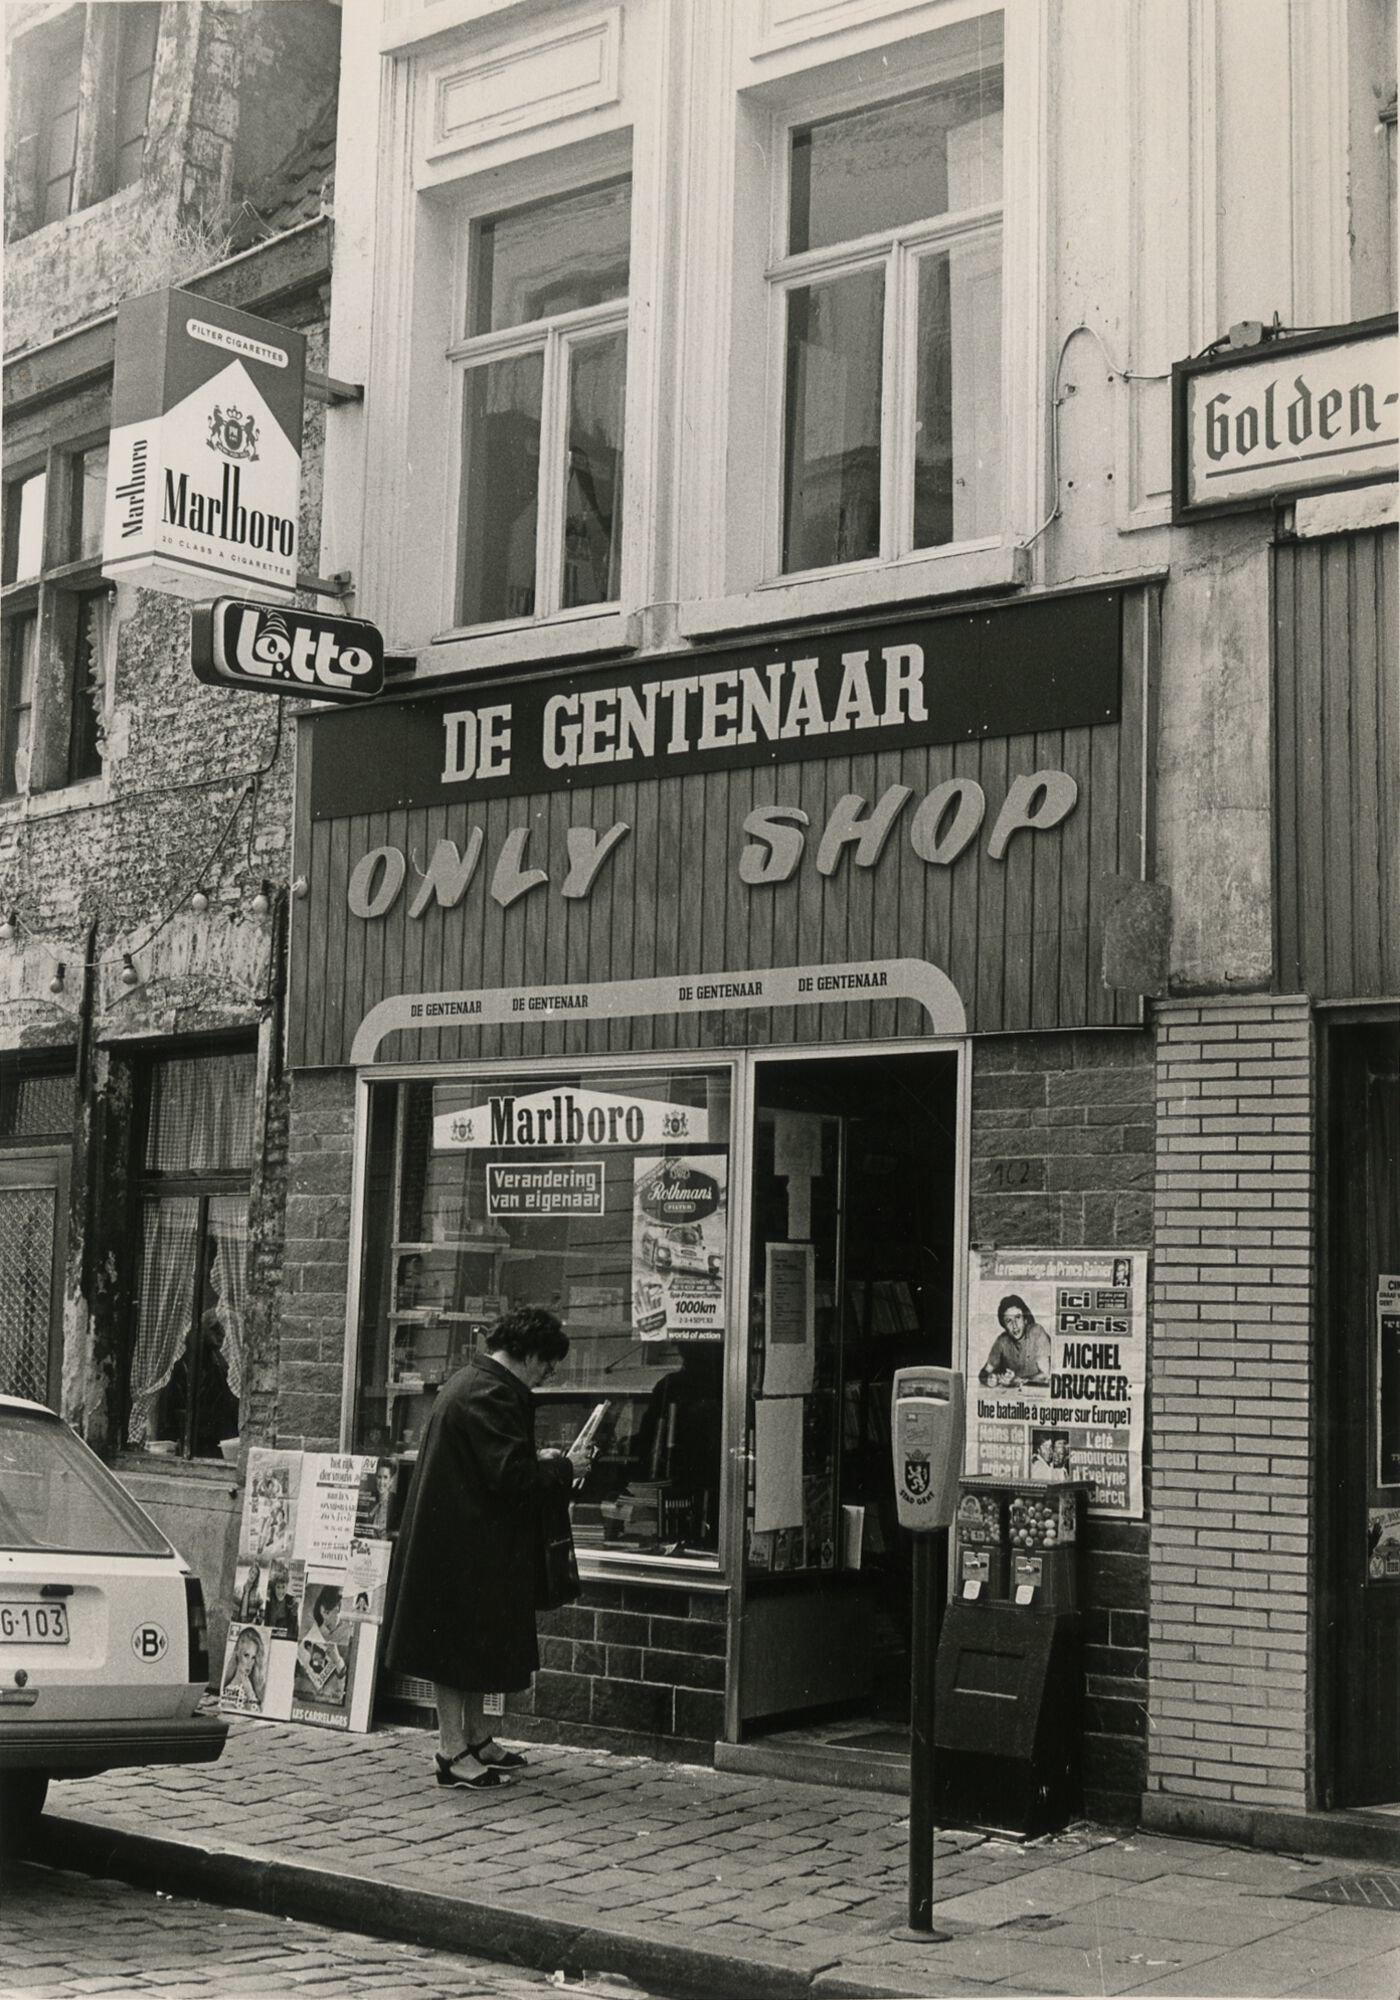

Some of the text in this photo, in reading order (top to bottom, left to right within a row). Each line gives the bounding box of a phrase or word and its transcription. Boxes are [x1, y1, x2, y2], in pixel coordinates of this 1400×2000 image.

[192, 324, 283, 362] FILTER CIGARETTES
[115, 440, 148, 538] Marlboro
[161, 462, 294, 557] Marlboro
[179, 540, 212, 555] CLASS
[231, 554, 291, 576] CIGARETTES
[236, 608, 373, 689] Lotto
[441, 643, 929, 783] DE GENTENAAR
[347, 769, 1079, 920] ONLY SHOP
[678, 981, 763, 1001] DE GENTENAAR
[798, 972, 888, 992] DE GENTENAAR
[410, 1000, 482, 1018] DE GENTENAAR
[512, 994, 589, 1012] DE GENTENAAR
[489, 1095, 645, 1146] Marlboro
[494, 1170, 596, 1191] Verandering
[647, 1180, 713, 1201] Rothmans
[491, 1191, 601, 1211] van eigenaar
[675, 1300, 716, 1314] 1000km
[1060, 1291, 1090, 1308] ici
[1060, 1313, 1128, 1332] Paris
[668, 1331, 721, 1340] world of action
[1062, 1342, 1122, 1370] MICHEL
[1050, 1373, 1132, 1402] DRUCKER:
[977, 1400, 995, 1418] Une
[996, 1401, 1030, 1420] bataille
[1031, 1404, 1038, 1420] à
[1039, 1407, 1074, 1426] gagner
[1075, 1410, 1089, 1423] sur
[1011, 1426, 1024, 1444] de
[1086, 1431, 1113, 1449] L'été
[980, 1444, 1022, 1461] cancers
[1070, 1451, 1127, 1467] amoureux
[899, 1489, 935, 1505] STAD GENT
[1088, 1488, 1126, 1507] clercq
[350, 1538, 371, 1557] Flair
[142, 1629, 159, 1657] B
